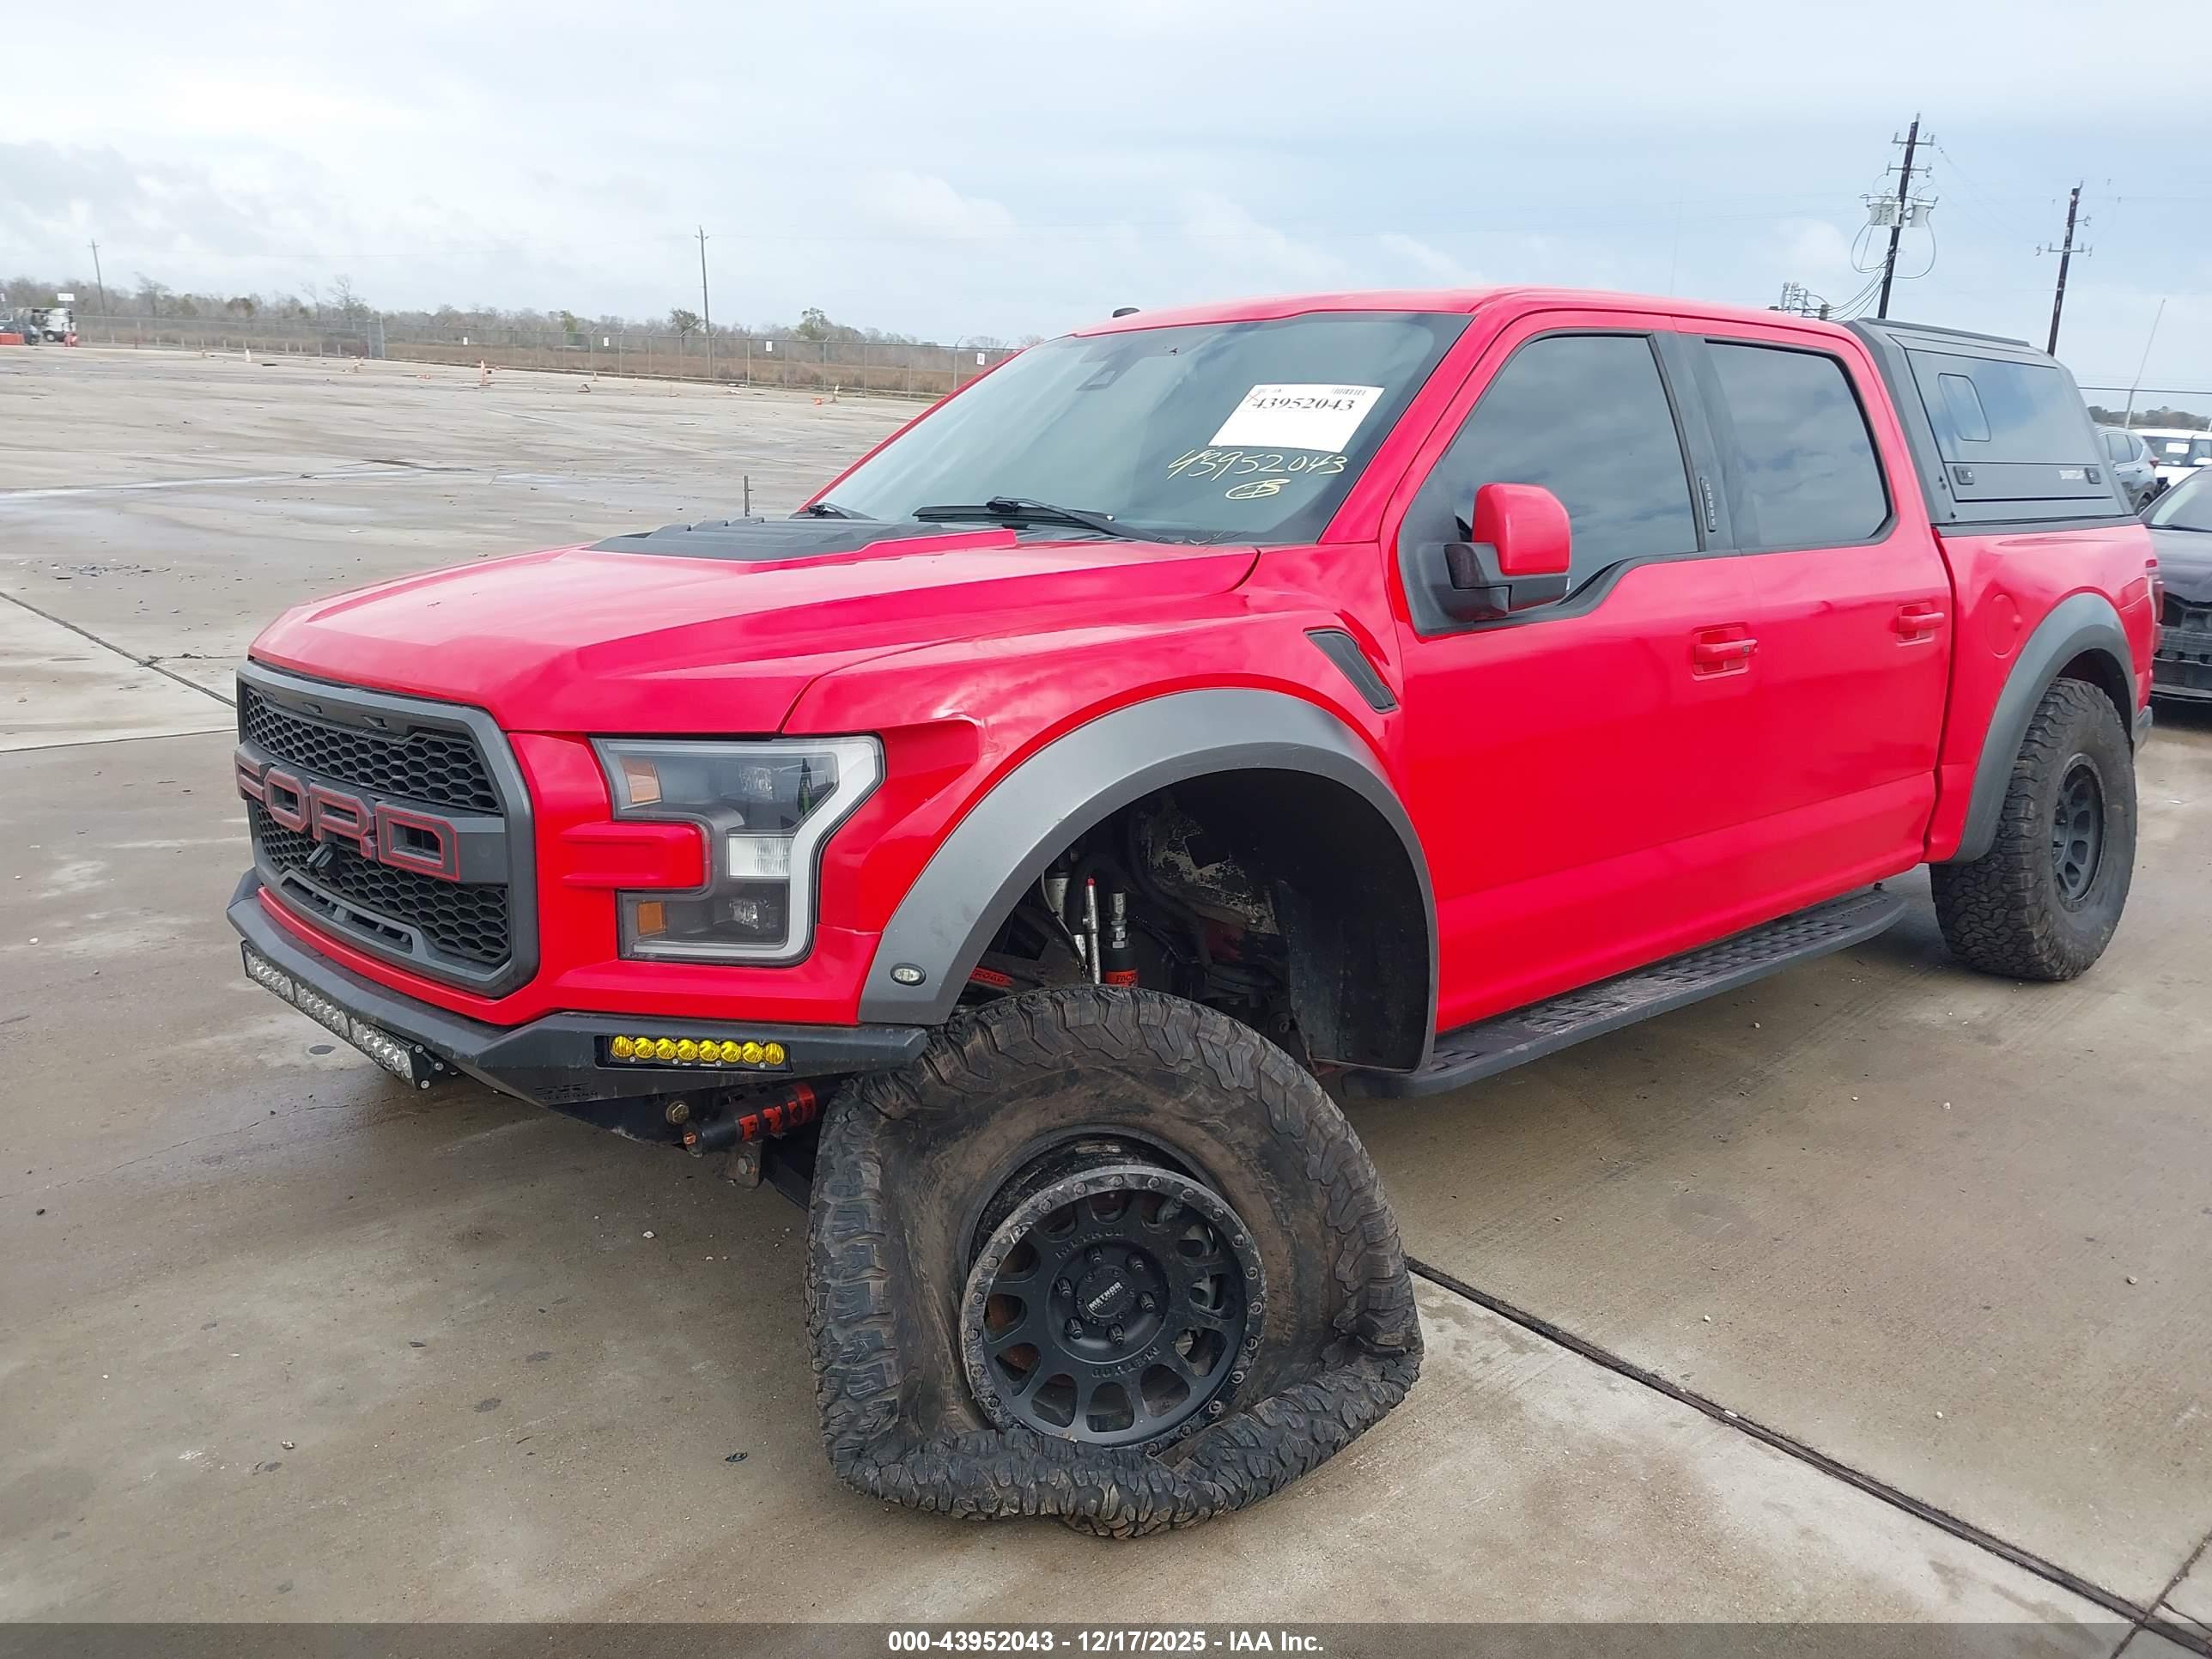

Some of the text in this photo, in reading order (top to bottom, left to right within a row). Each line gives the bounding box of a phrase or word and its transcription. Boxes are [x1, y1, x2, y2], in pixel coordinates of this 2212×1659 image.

[1252, 398, 1356, 411] 43952043
[1167, 449, 1349, 482] 43952043
[234, 750, 461, 882] FORD
[1088, 1281, 1122, 1311] METHOD
